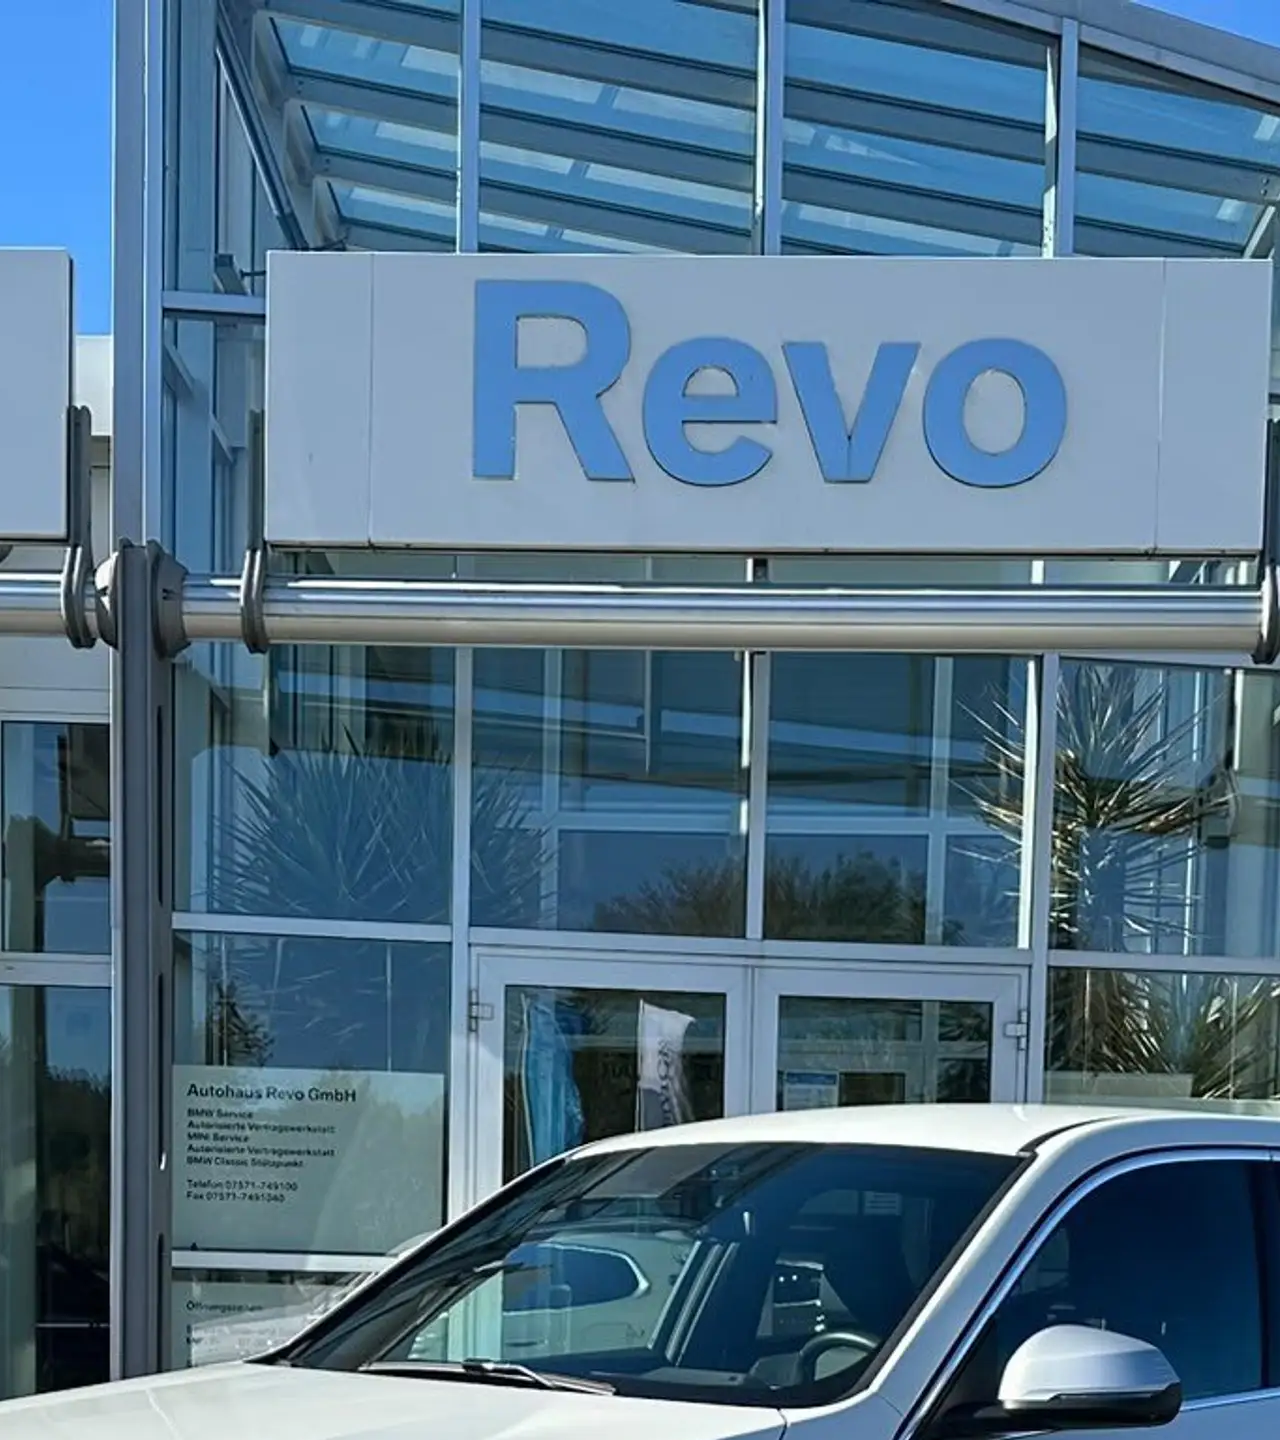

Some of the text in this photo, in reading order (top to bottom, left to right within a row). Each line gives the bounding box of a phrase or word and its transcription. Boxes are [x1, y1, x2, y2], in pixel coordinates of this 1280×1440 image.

[471, 278, 1068, 489] Revo
[186, 1083, 357, 1102] Autohaus Revo GmbH
[186, 1108, 253, 1119] BMW Service
[212, 1133, 249, 1143] Service
[186, 1156, 213, 1166] BMW
[186, 1179, 223, 1189] Telefon
[186, 1191, 204, 1201] Fax
